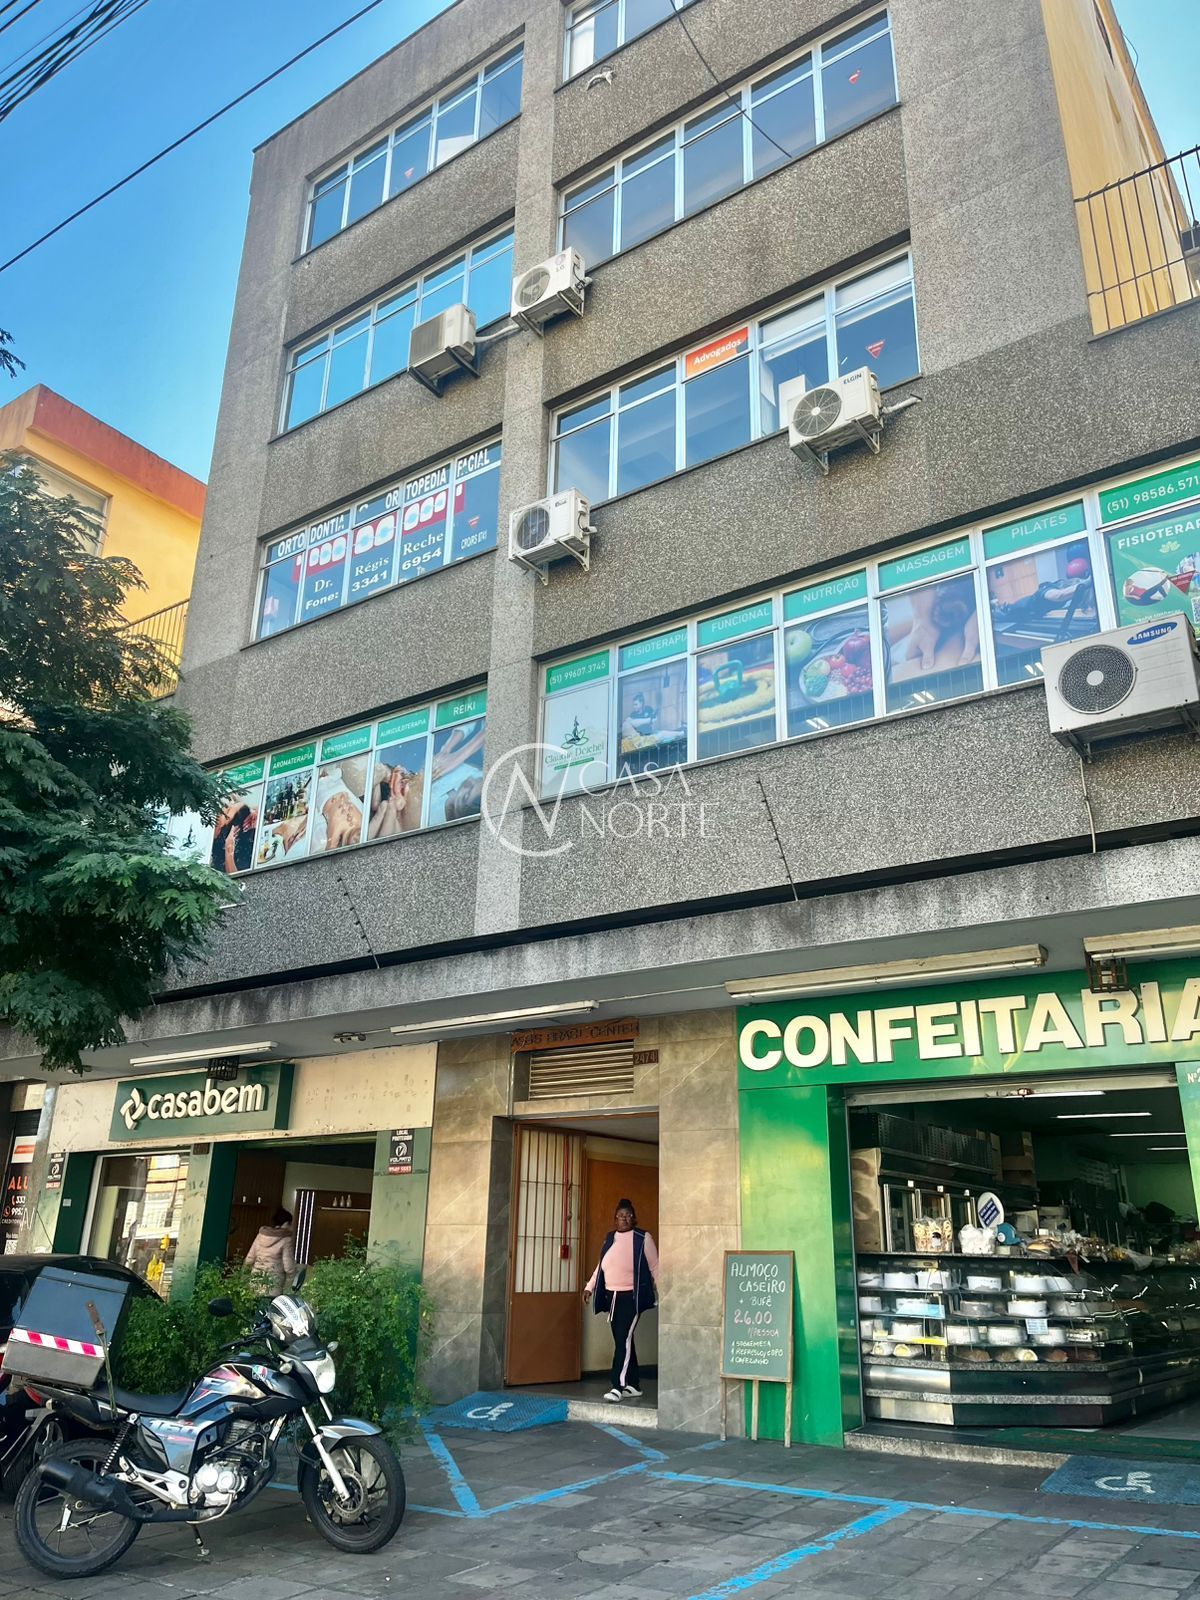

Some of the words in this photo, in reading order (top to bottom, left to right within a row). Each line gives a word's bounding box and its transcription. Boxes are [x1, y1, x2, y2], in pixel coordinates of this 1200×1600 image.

[693, 338, 742, 365] Advogados
[843, 372, 862, 384] ELGIN
[1107, 497, 1129, 514] (51)
[1010, 512, 1068, 539] PILATES
[314, 577, 333, 593] Dr.
[354, 555, 390, 578] Régis
[403, 531, 444, 556] Reche
[895, 543, 965, 574] MASSAGEM
[305, 591, 339, 610] Fone:
[351, 570, 388, 592] 3341
[402, 548, 442, 572] 6954
[802, 577, 859, 604] NUTRIÇÃO
[711, 607, 770, 632] FUNCIONAL
[549, 672, 563, 687] (51)
[453, 701, 476, 717] REIKI
[324, 736, 368, 754] VENTOSATERAPIA
[272, 753, 313, 769] AROMATERAPIA
[147, 1080, 263, 1120] casabem
[730, 1262, 779, 1281] ALMOÇO
[734, 1309, 773, 1325] 26.00
